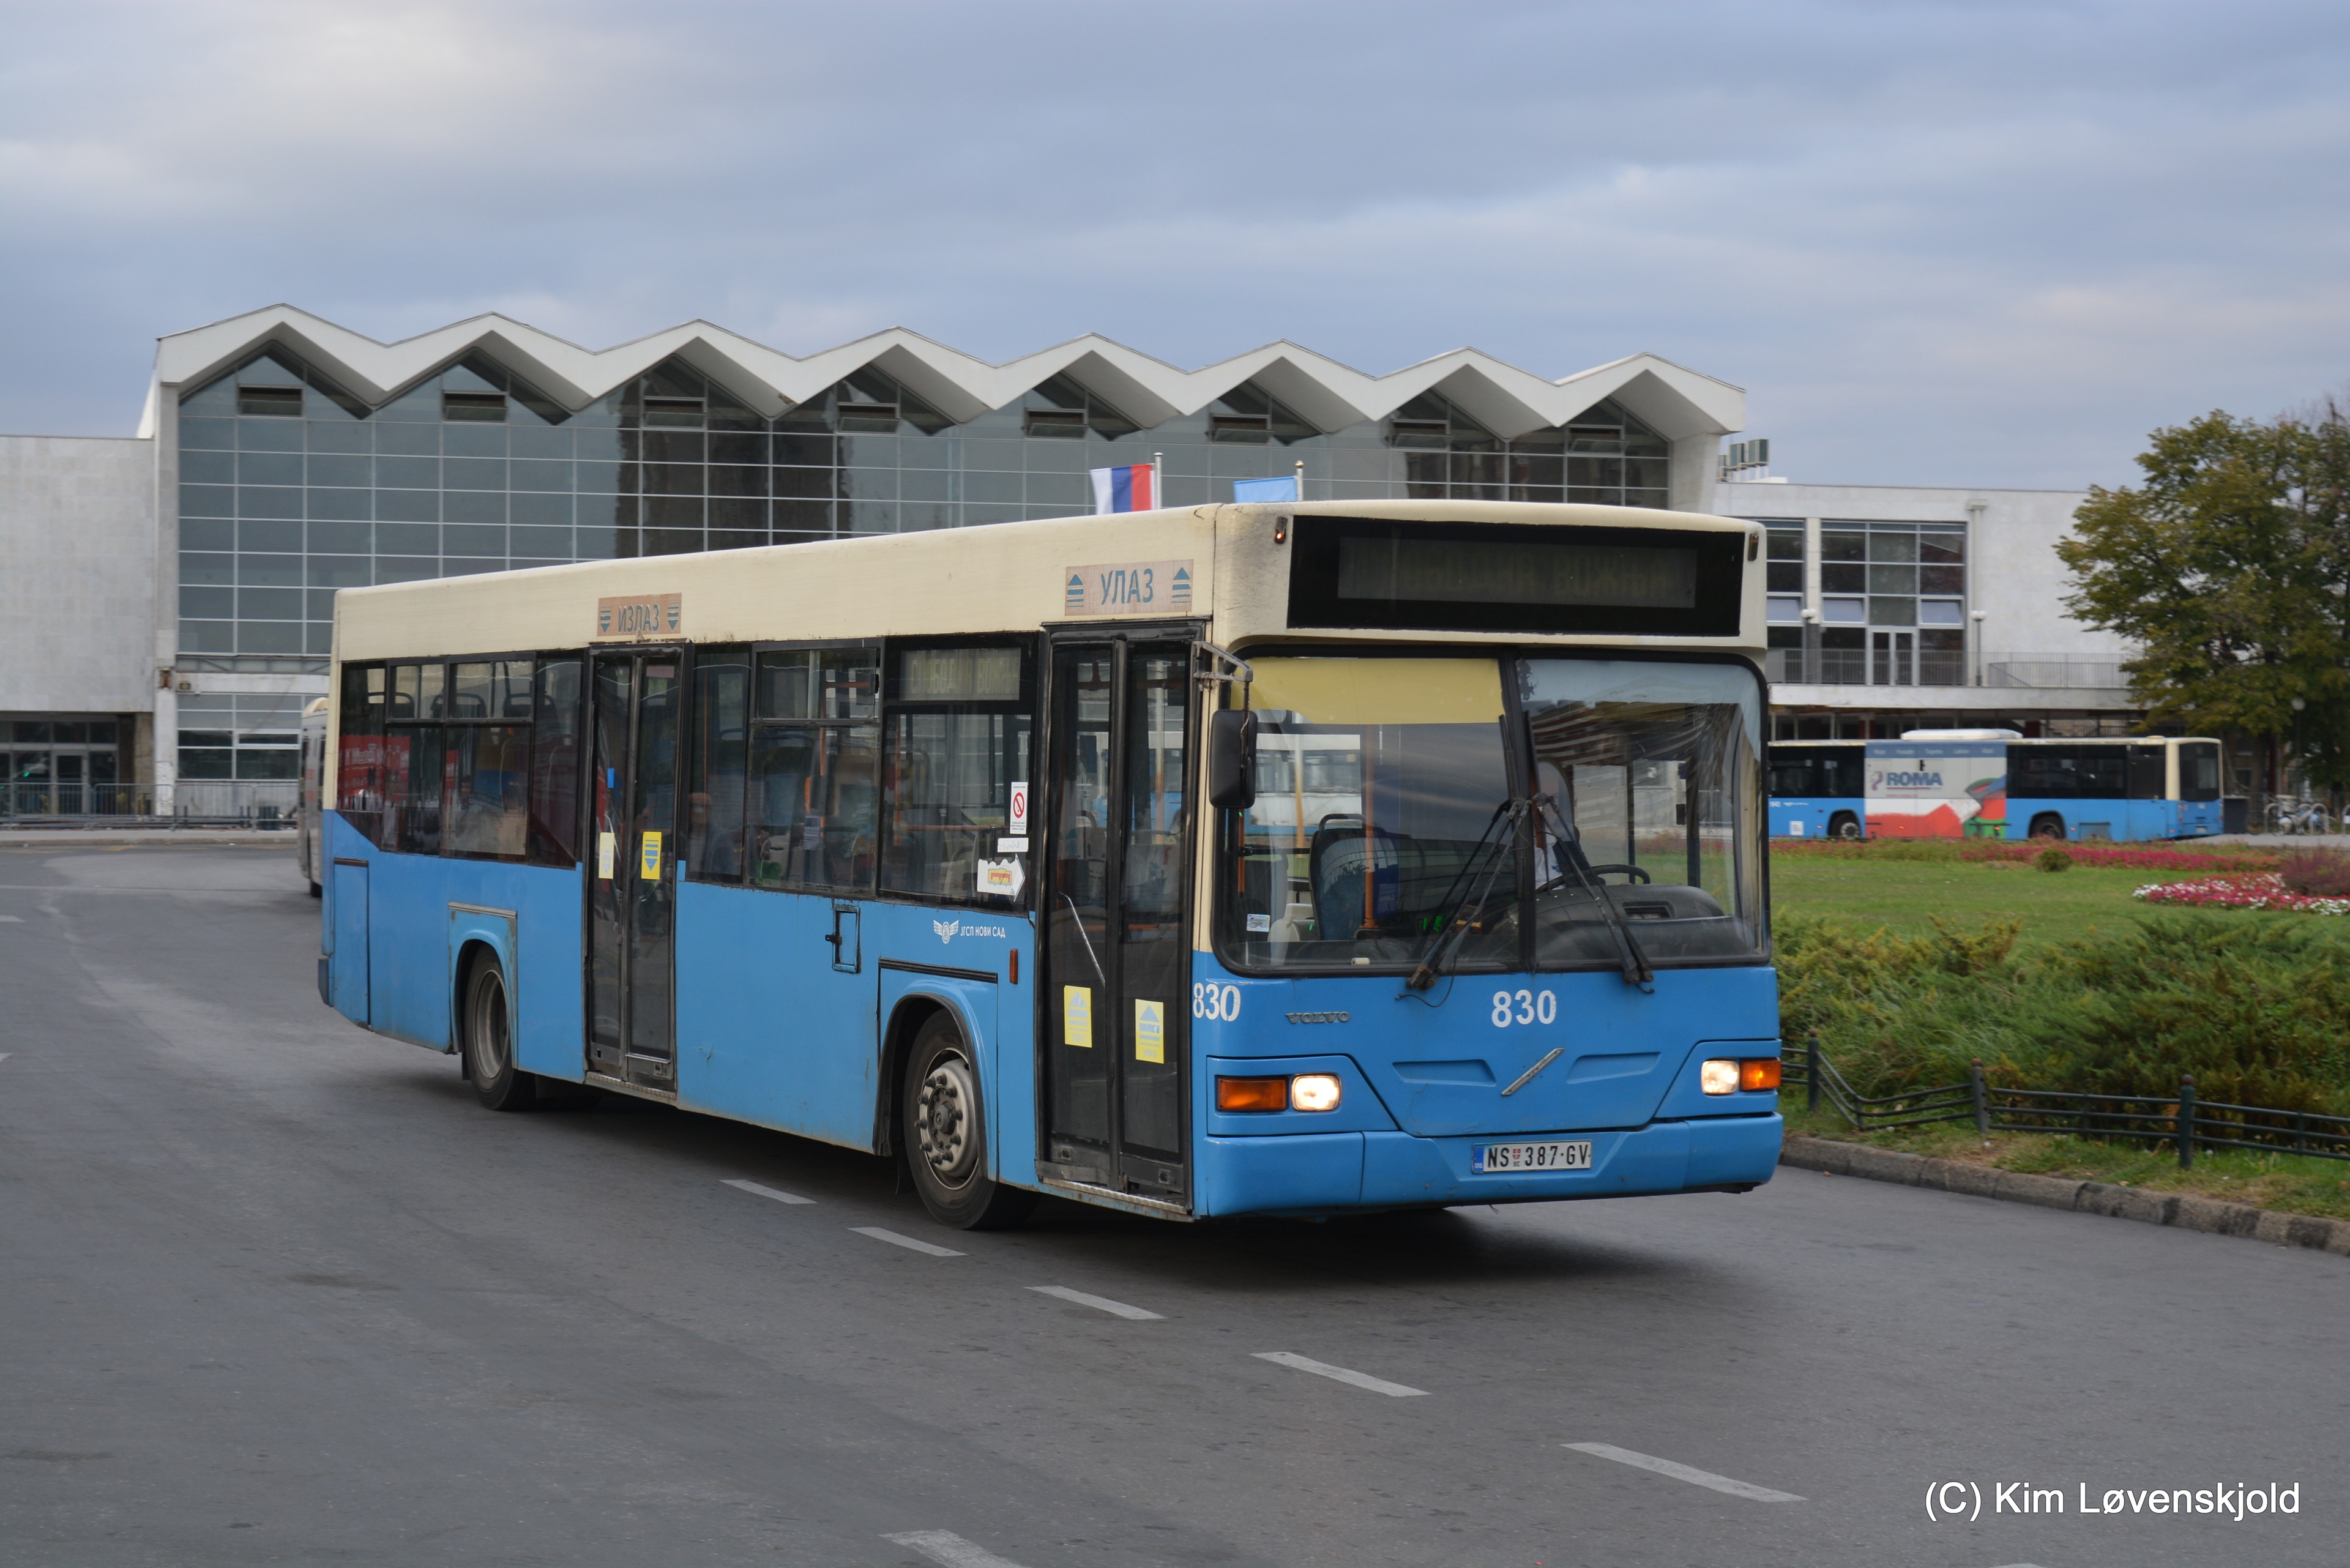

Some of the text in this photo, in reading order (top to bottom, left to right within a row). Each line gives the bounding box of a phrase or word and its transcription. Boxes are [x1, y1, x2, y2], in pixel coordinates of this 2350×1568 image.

[1101, 568, 1154, 605] УЛАЗ
[617, 603, 660, 632] ИЗЛАЗ
[1886, 772, 1943, 786] ROMA
[975, 926, 991, 937] НОВИ
[992, 927, 1006, 939] САД
[1193, 982, 1241, 1022] 830
[1491, 989, 1557, 1028] 830
[1286, 1012, 1351, 1024] VOLVO
[1487, 1147, 1510, 1168] NS
